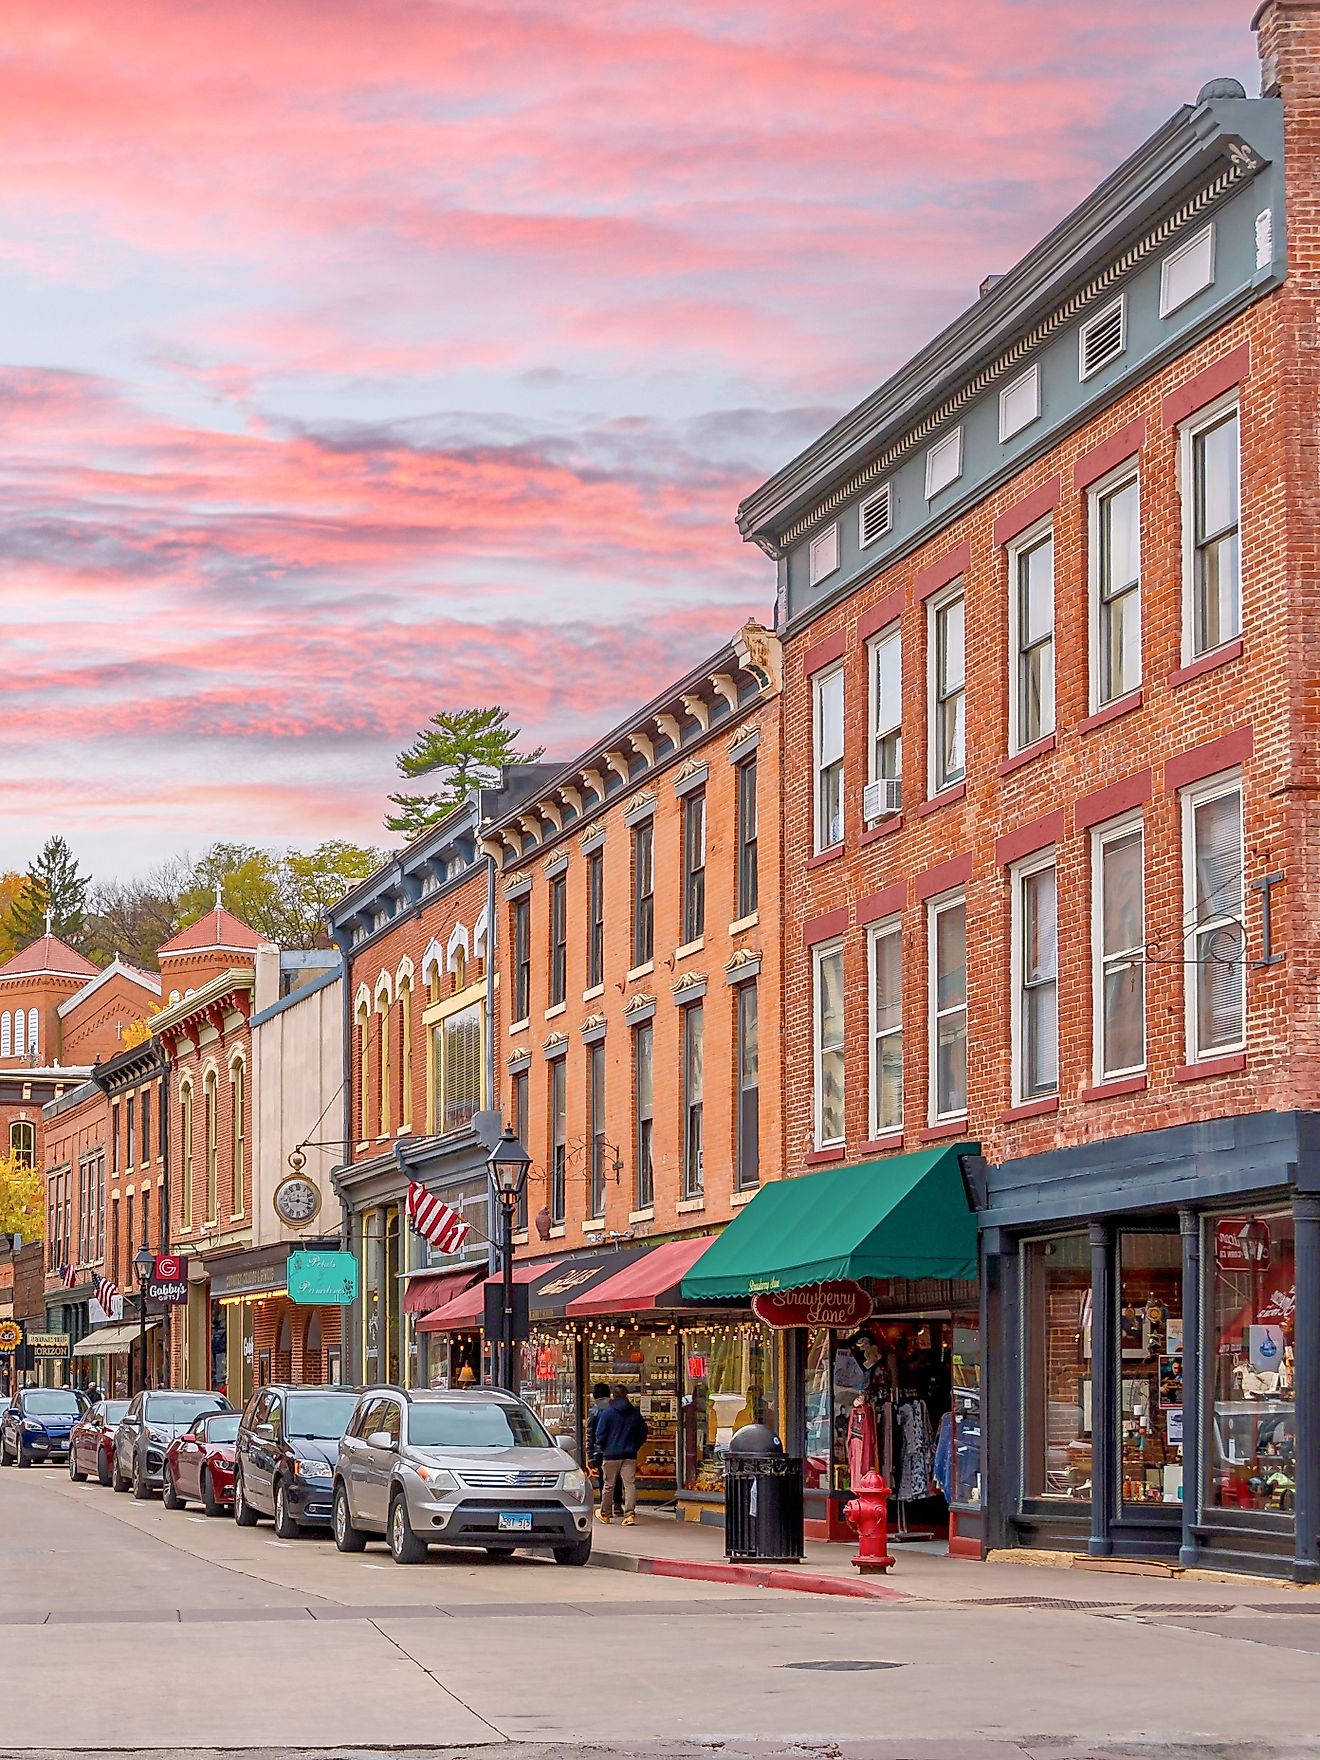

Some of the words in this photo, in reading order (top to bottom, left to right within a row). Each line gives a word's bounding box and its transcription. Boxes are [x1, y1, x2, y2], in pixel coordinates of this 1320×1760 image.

[159, 1258, 176, 1277] G
[149, 1282, 187, 1300] Gabby's
[772, 1285, 856, 1316] Strawberry
[806, 1302, 848, 1323] Lane
